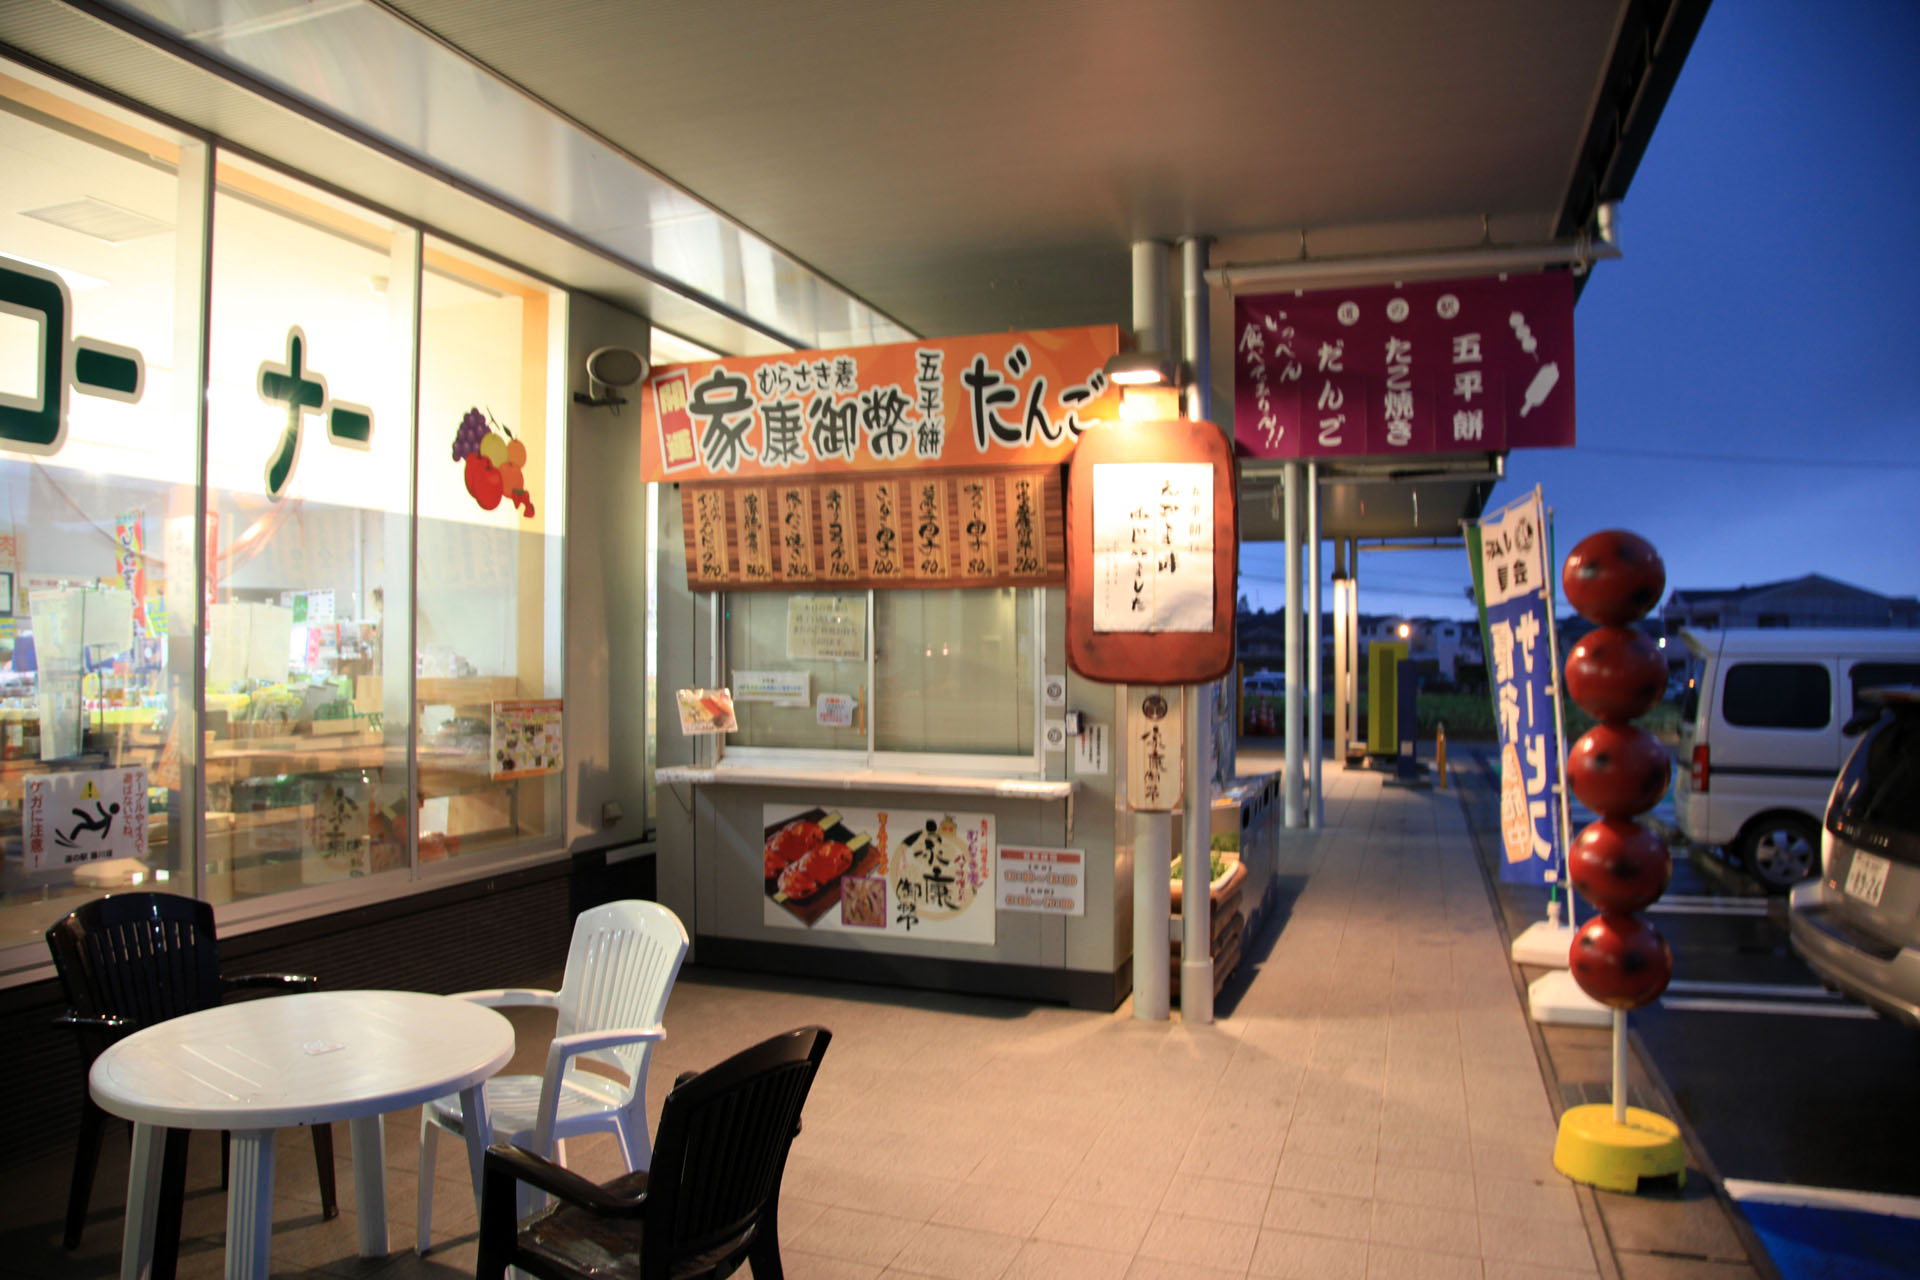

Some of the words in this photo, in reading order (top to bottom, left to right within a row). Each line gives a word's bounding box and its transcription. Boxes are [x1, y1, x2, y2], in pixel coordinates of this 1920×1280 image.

[689, 368, 912, 469] 家康御幣
[758, 355, 857, 395] むらさき麦
[917, 351, 943, 457] 五平餅
[1317, 339, 1346, 447] だんご
[1384, 336, 1414, 446] たこ焼き
[1452, 333, 1484, 441] 五平餅
